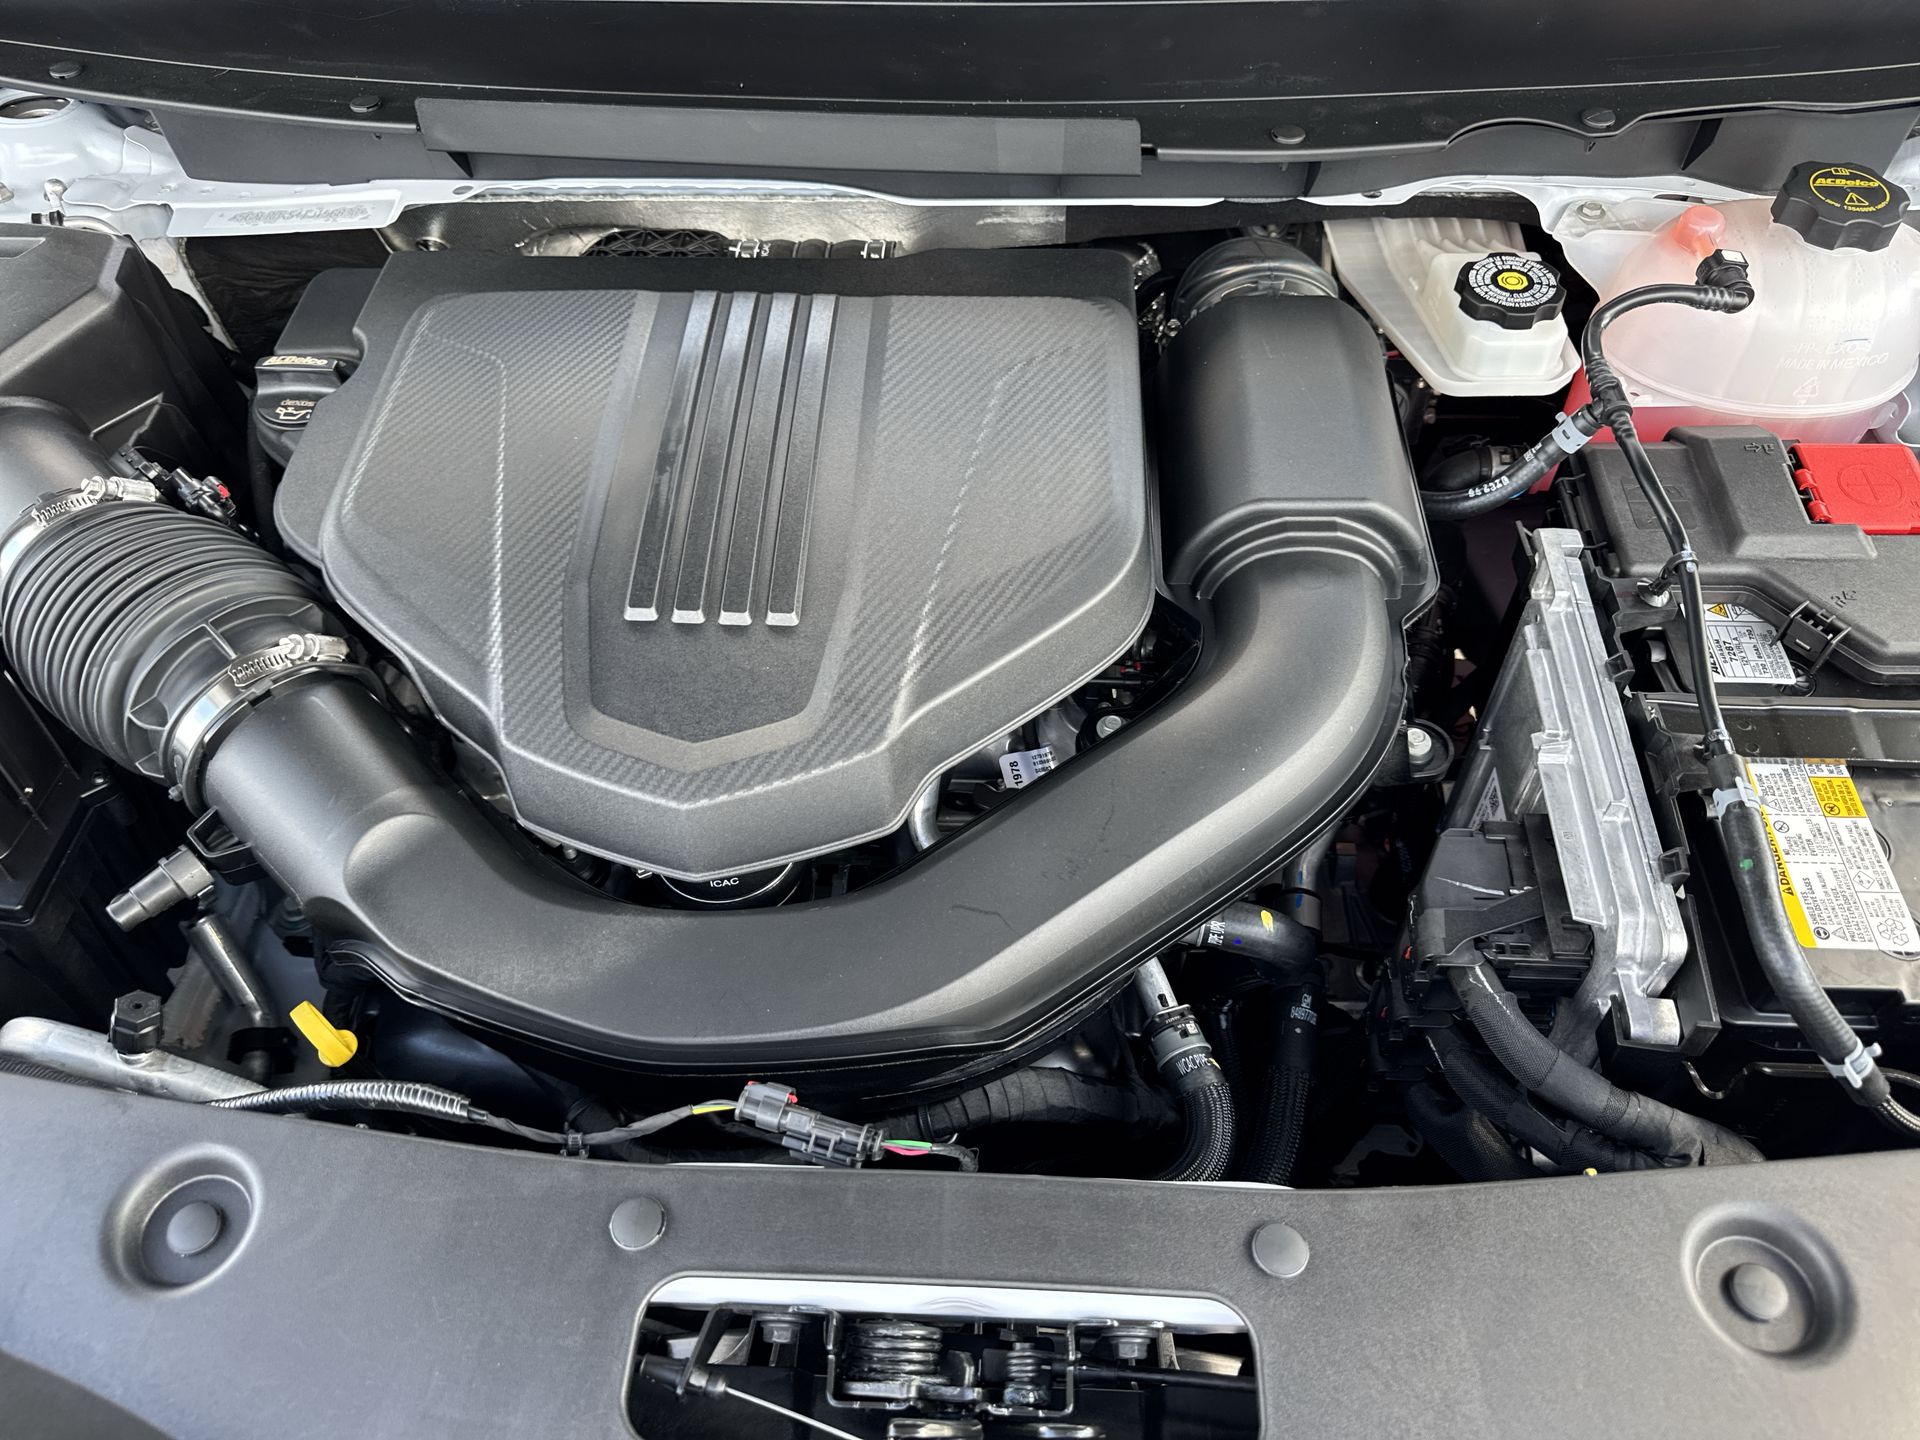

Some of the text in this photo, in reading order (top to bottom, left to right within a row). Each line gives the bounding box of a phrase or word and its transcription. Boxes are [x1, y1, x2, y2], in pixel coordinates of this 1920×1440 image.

[1815, 178, 1879, 187] ACDelco
[1816, 358, 1829, 369] IN
[1830, 352, 1888, 370] MEXICO
[1722, 640, 1738, 662] 7287
[1009, 761, 1023, 786] 1978
[710, 878, 739, 888] ICAC
[1802, 877, 1827, 925] EXPLOSIVE GASES
[1836, 903, 1846, 912] LES
[1839, 890, 1856, 918] EXPLOSIFS
[1806, 906, 1819, 924] SHIELD
[1851, 920, 1861, 930] GAZ
[1856, 932, 1866, 941] LES
